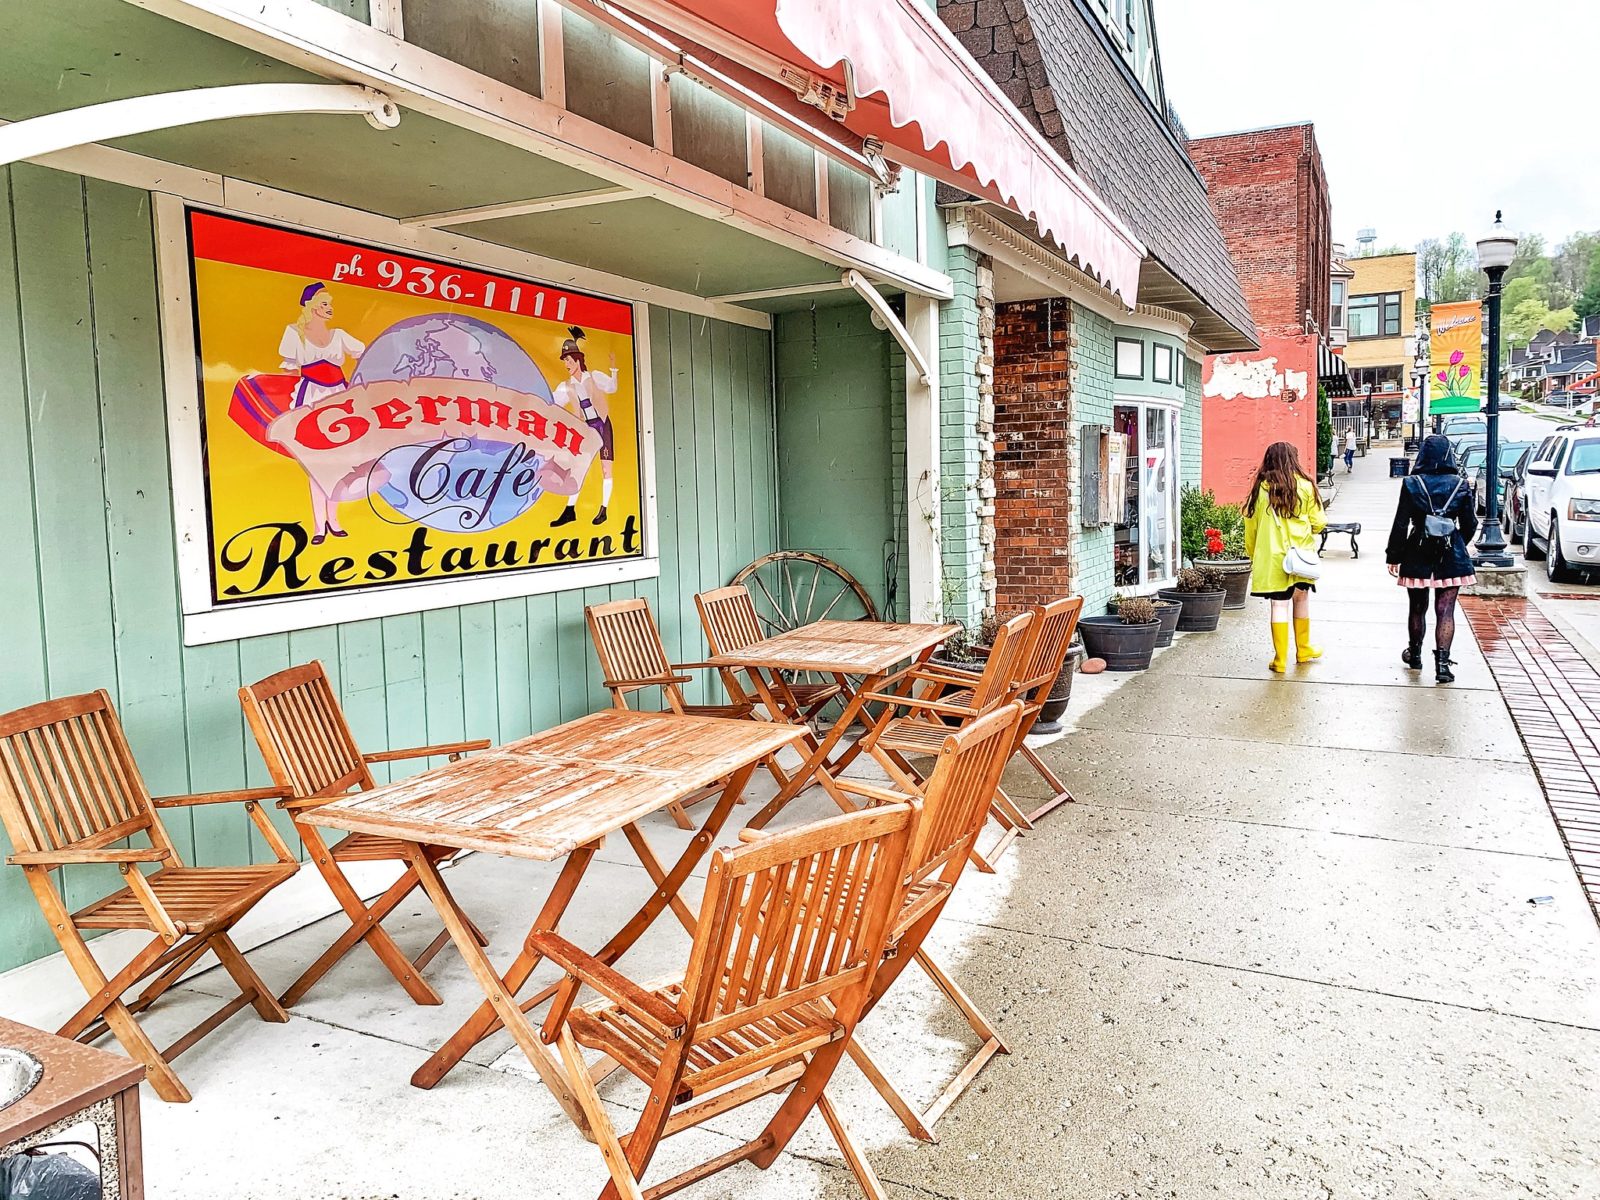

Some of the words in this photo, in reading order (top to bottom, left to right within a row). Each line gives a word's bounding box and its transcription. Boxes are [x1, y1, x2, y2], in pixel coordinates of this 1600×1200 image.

[332, 254, 365, 281] ph
[377, 260, 567, 321] 936-1111
[294, 395, 585, 456] German
[367, 437, 542, 530] Café
[220, 515, 640, 596] Restaurant
